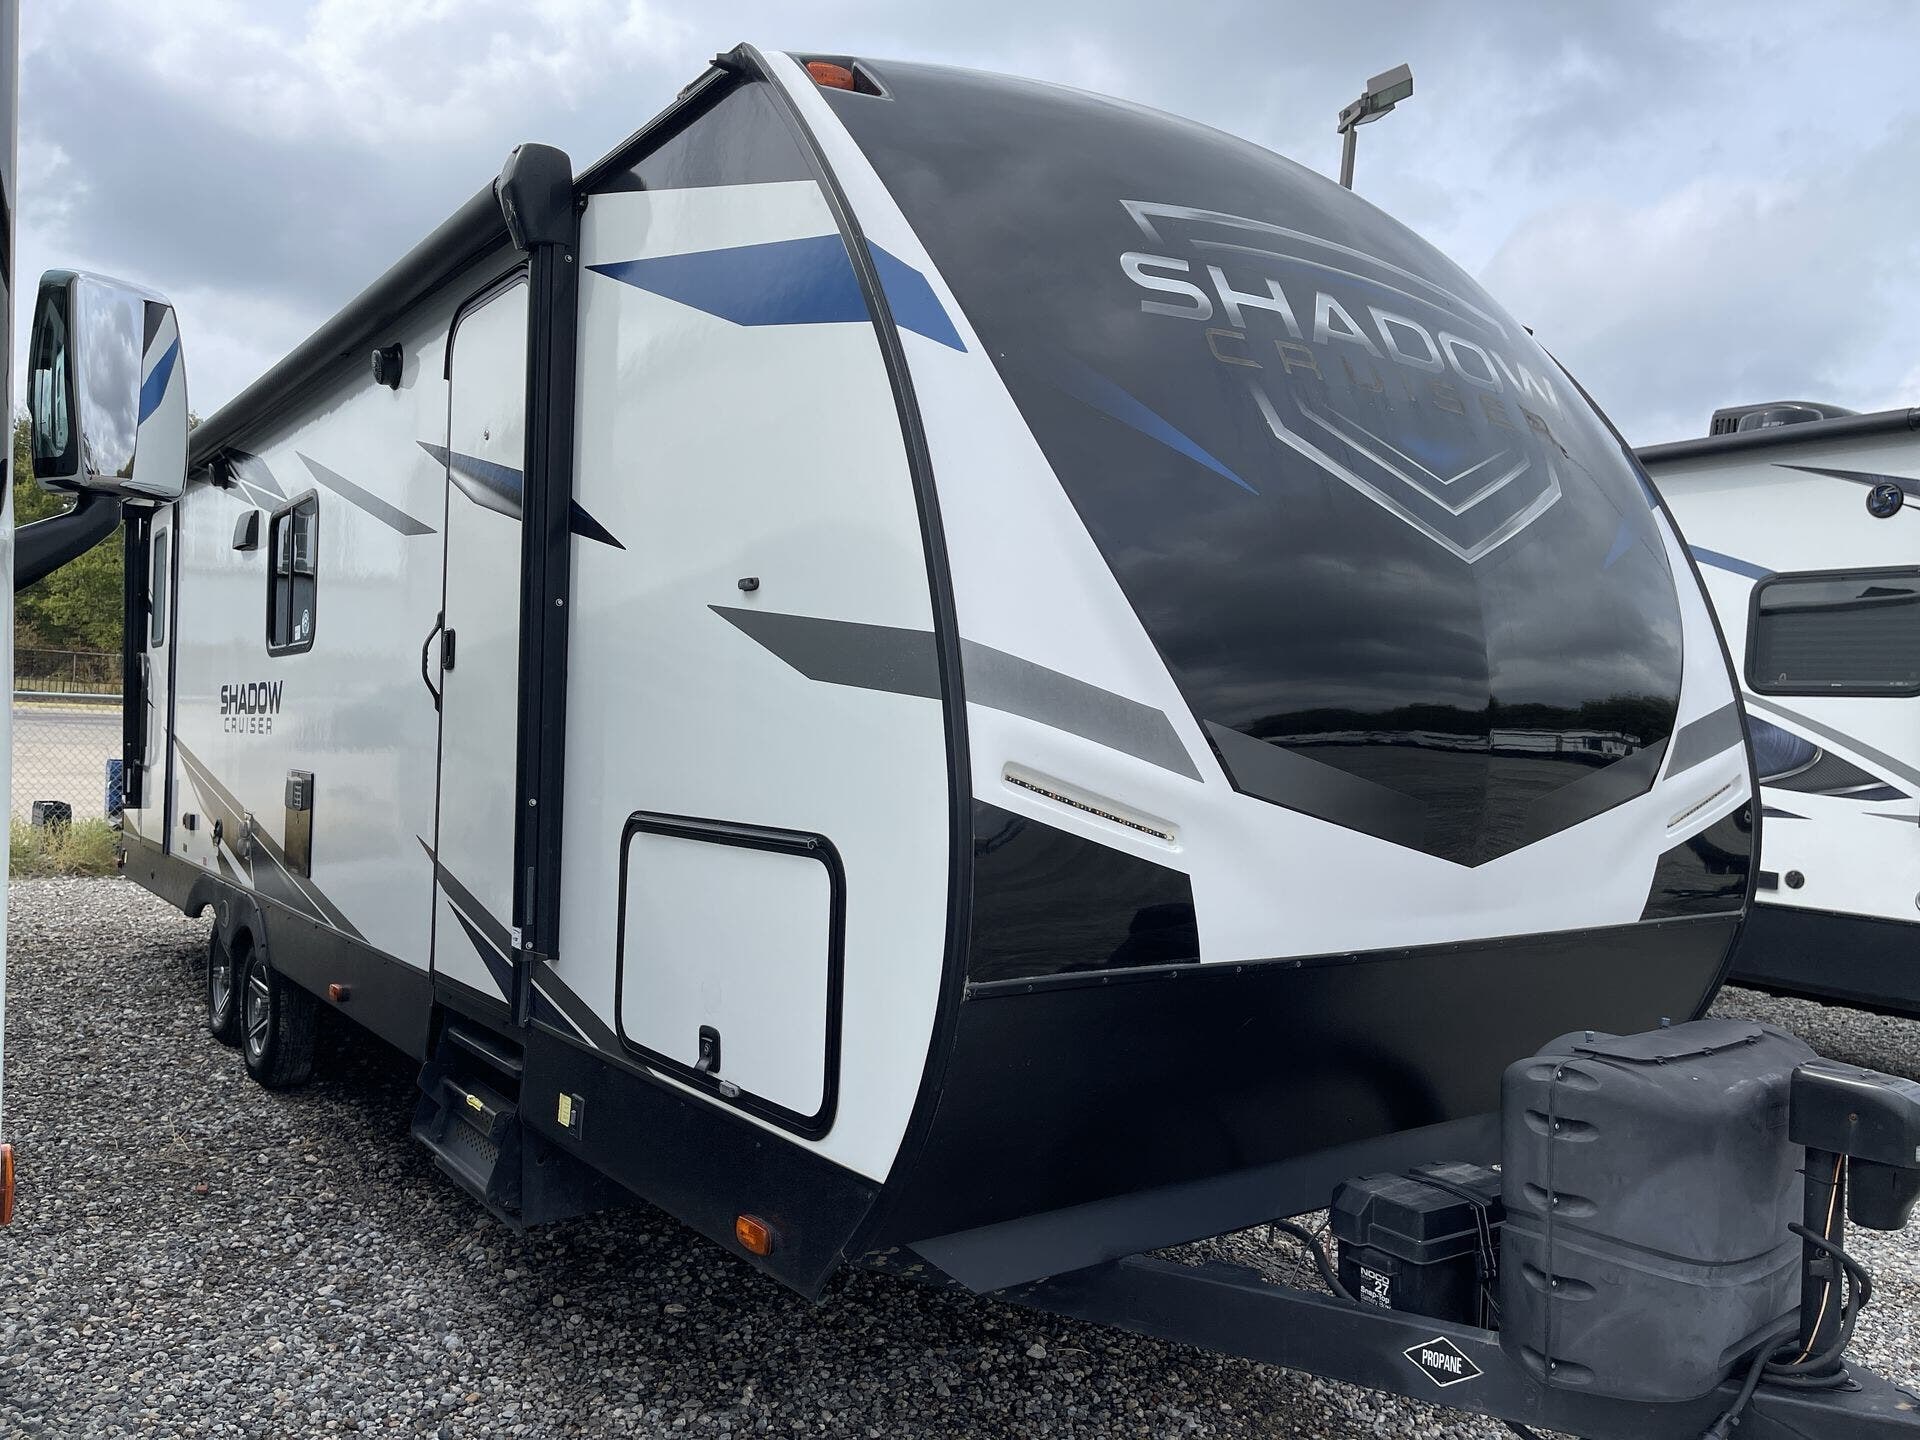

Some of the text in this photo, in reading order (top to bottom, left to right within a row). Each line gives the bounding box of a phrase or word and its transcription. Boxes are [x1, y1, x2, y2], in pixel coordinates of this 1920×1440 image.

[1120, 251, 1566, 421] SHADOW
[1205, 327, 1568, 459] CRUISER
[221, 680, 283, 715] SHADOW
[224, 717, 272, 734] CRUISER
[1361, 1267, 1390, 1285] NOCO
[1375, 1281, 1389, 1296] 27
[1422, 1349, 1462, 1375] PROPANE
